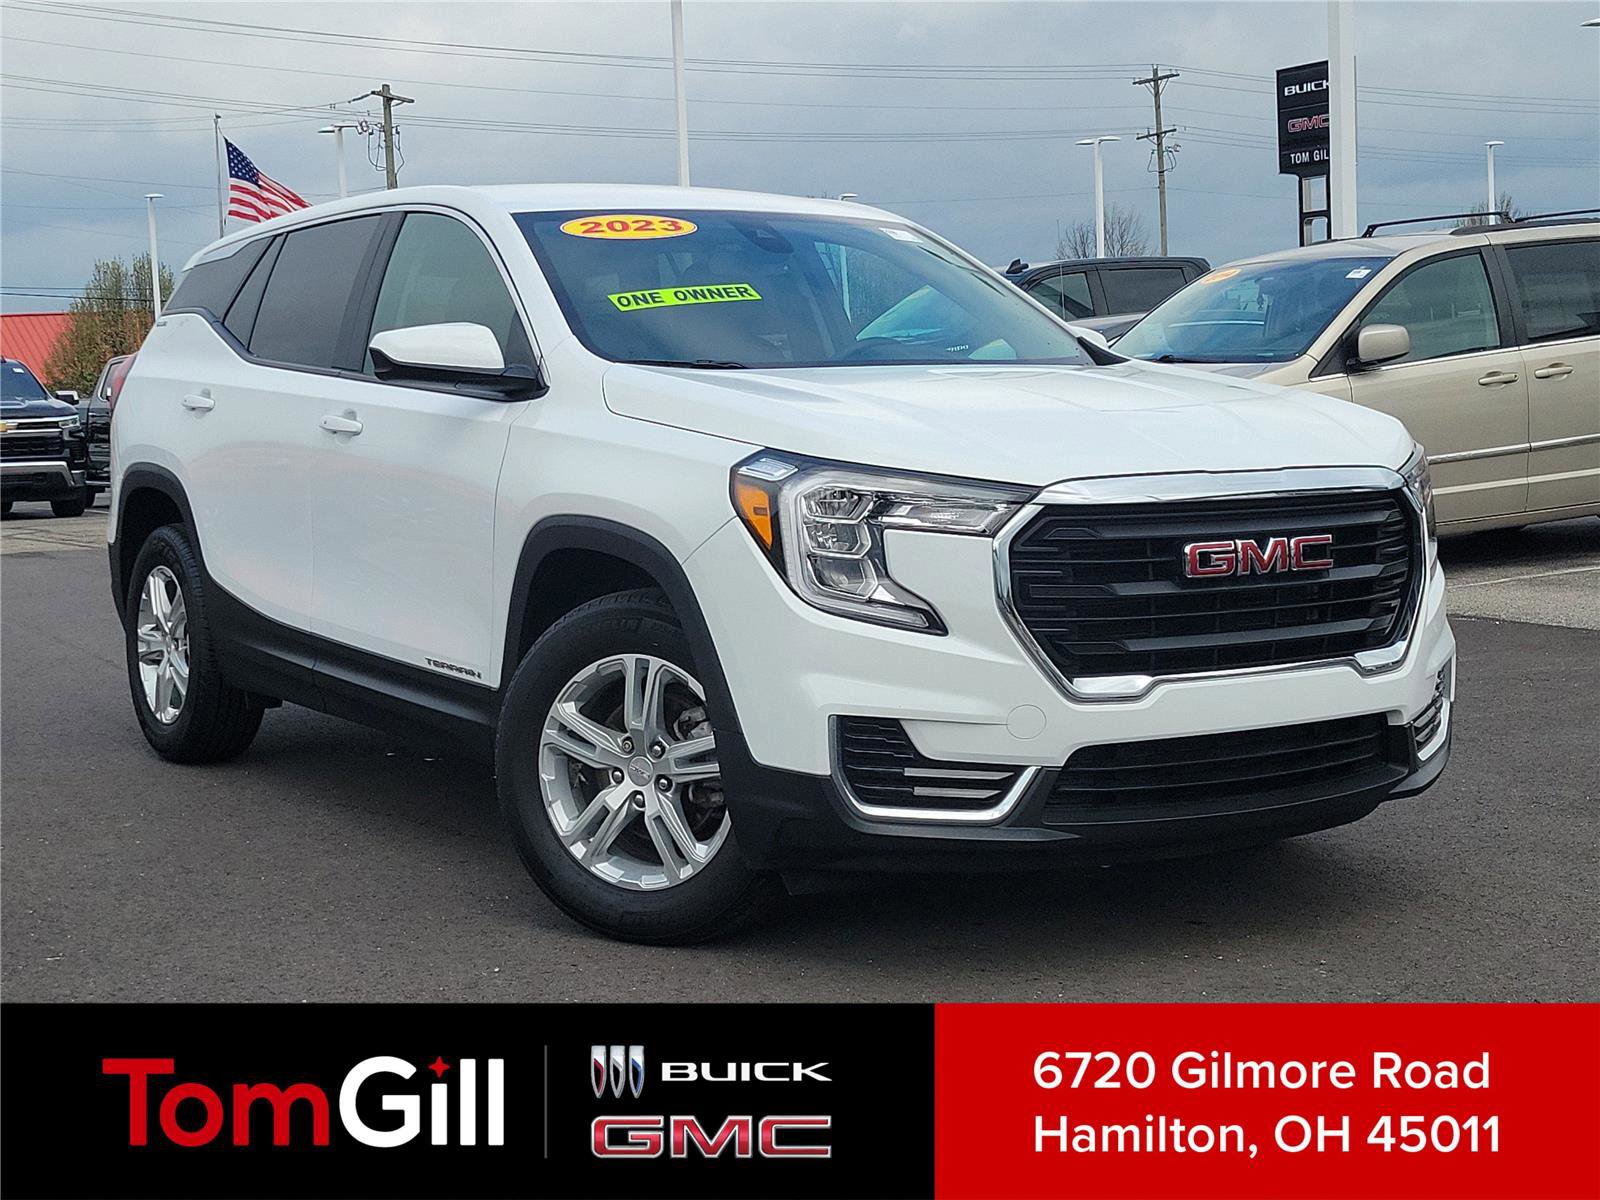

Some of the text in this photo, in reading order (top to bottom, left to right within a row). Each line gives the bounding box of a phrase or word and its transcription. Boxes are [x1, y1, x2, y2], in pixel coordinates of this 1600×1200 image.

[1287, 114, 1329, 133] GMC
[1290, 152, 1310, 164] TOM
[580, 219, 683, 235] 2023
[616, 286, 754, 308] ONE OWNER
[1184, 534, 1334, 578] GMC
